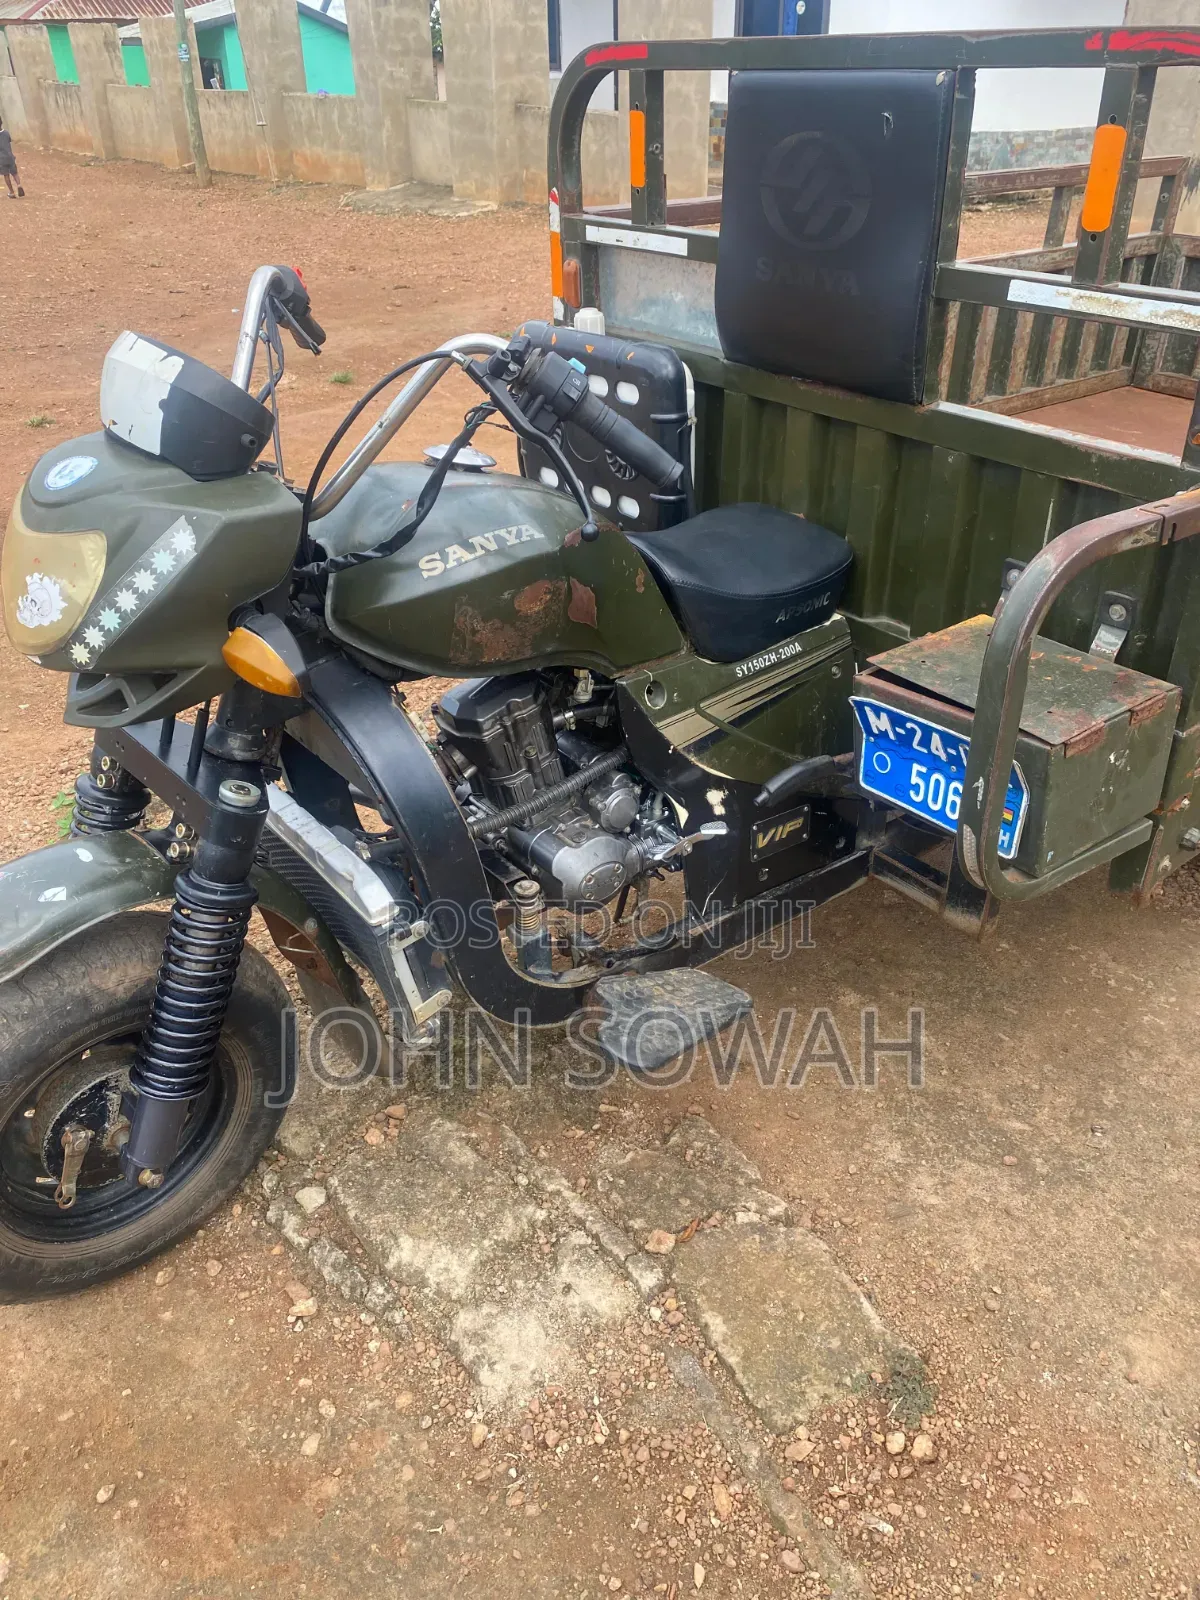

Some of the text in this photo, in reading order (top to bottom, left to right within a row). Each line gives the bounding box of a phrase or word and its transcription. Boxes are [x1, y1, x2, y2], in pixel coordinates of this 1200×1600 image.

[755, 256, 861, 296] SANYA
[418, 524, 545, 579] SANYA
[775, 592, 831, 624] APSONIC
[735, 641, 803, 678] SY150ZH-200A
[755, 816, 805, 849] VIP
